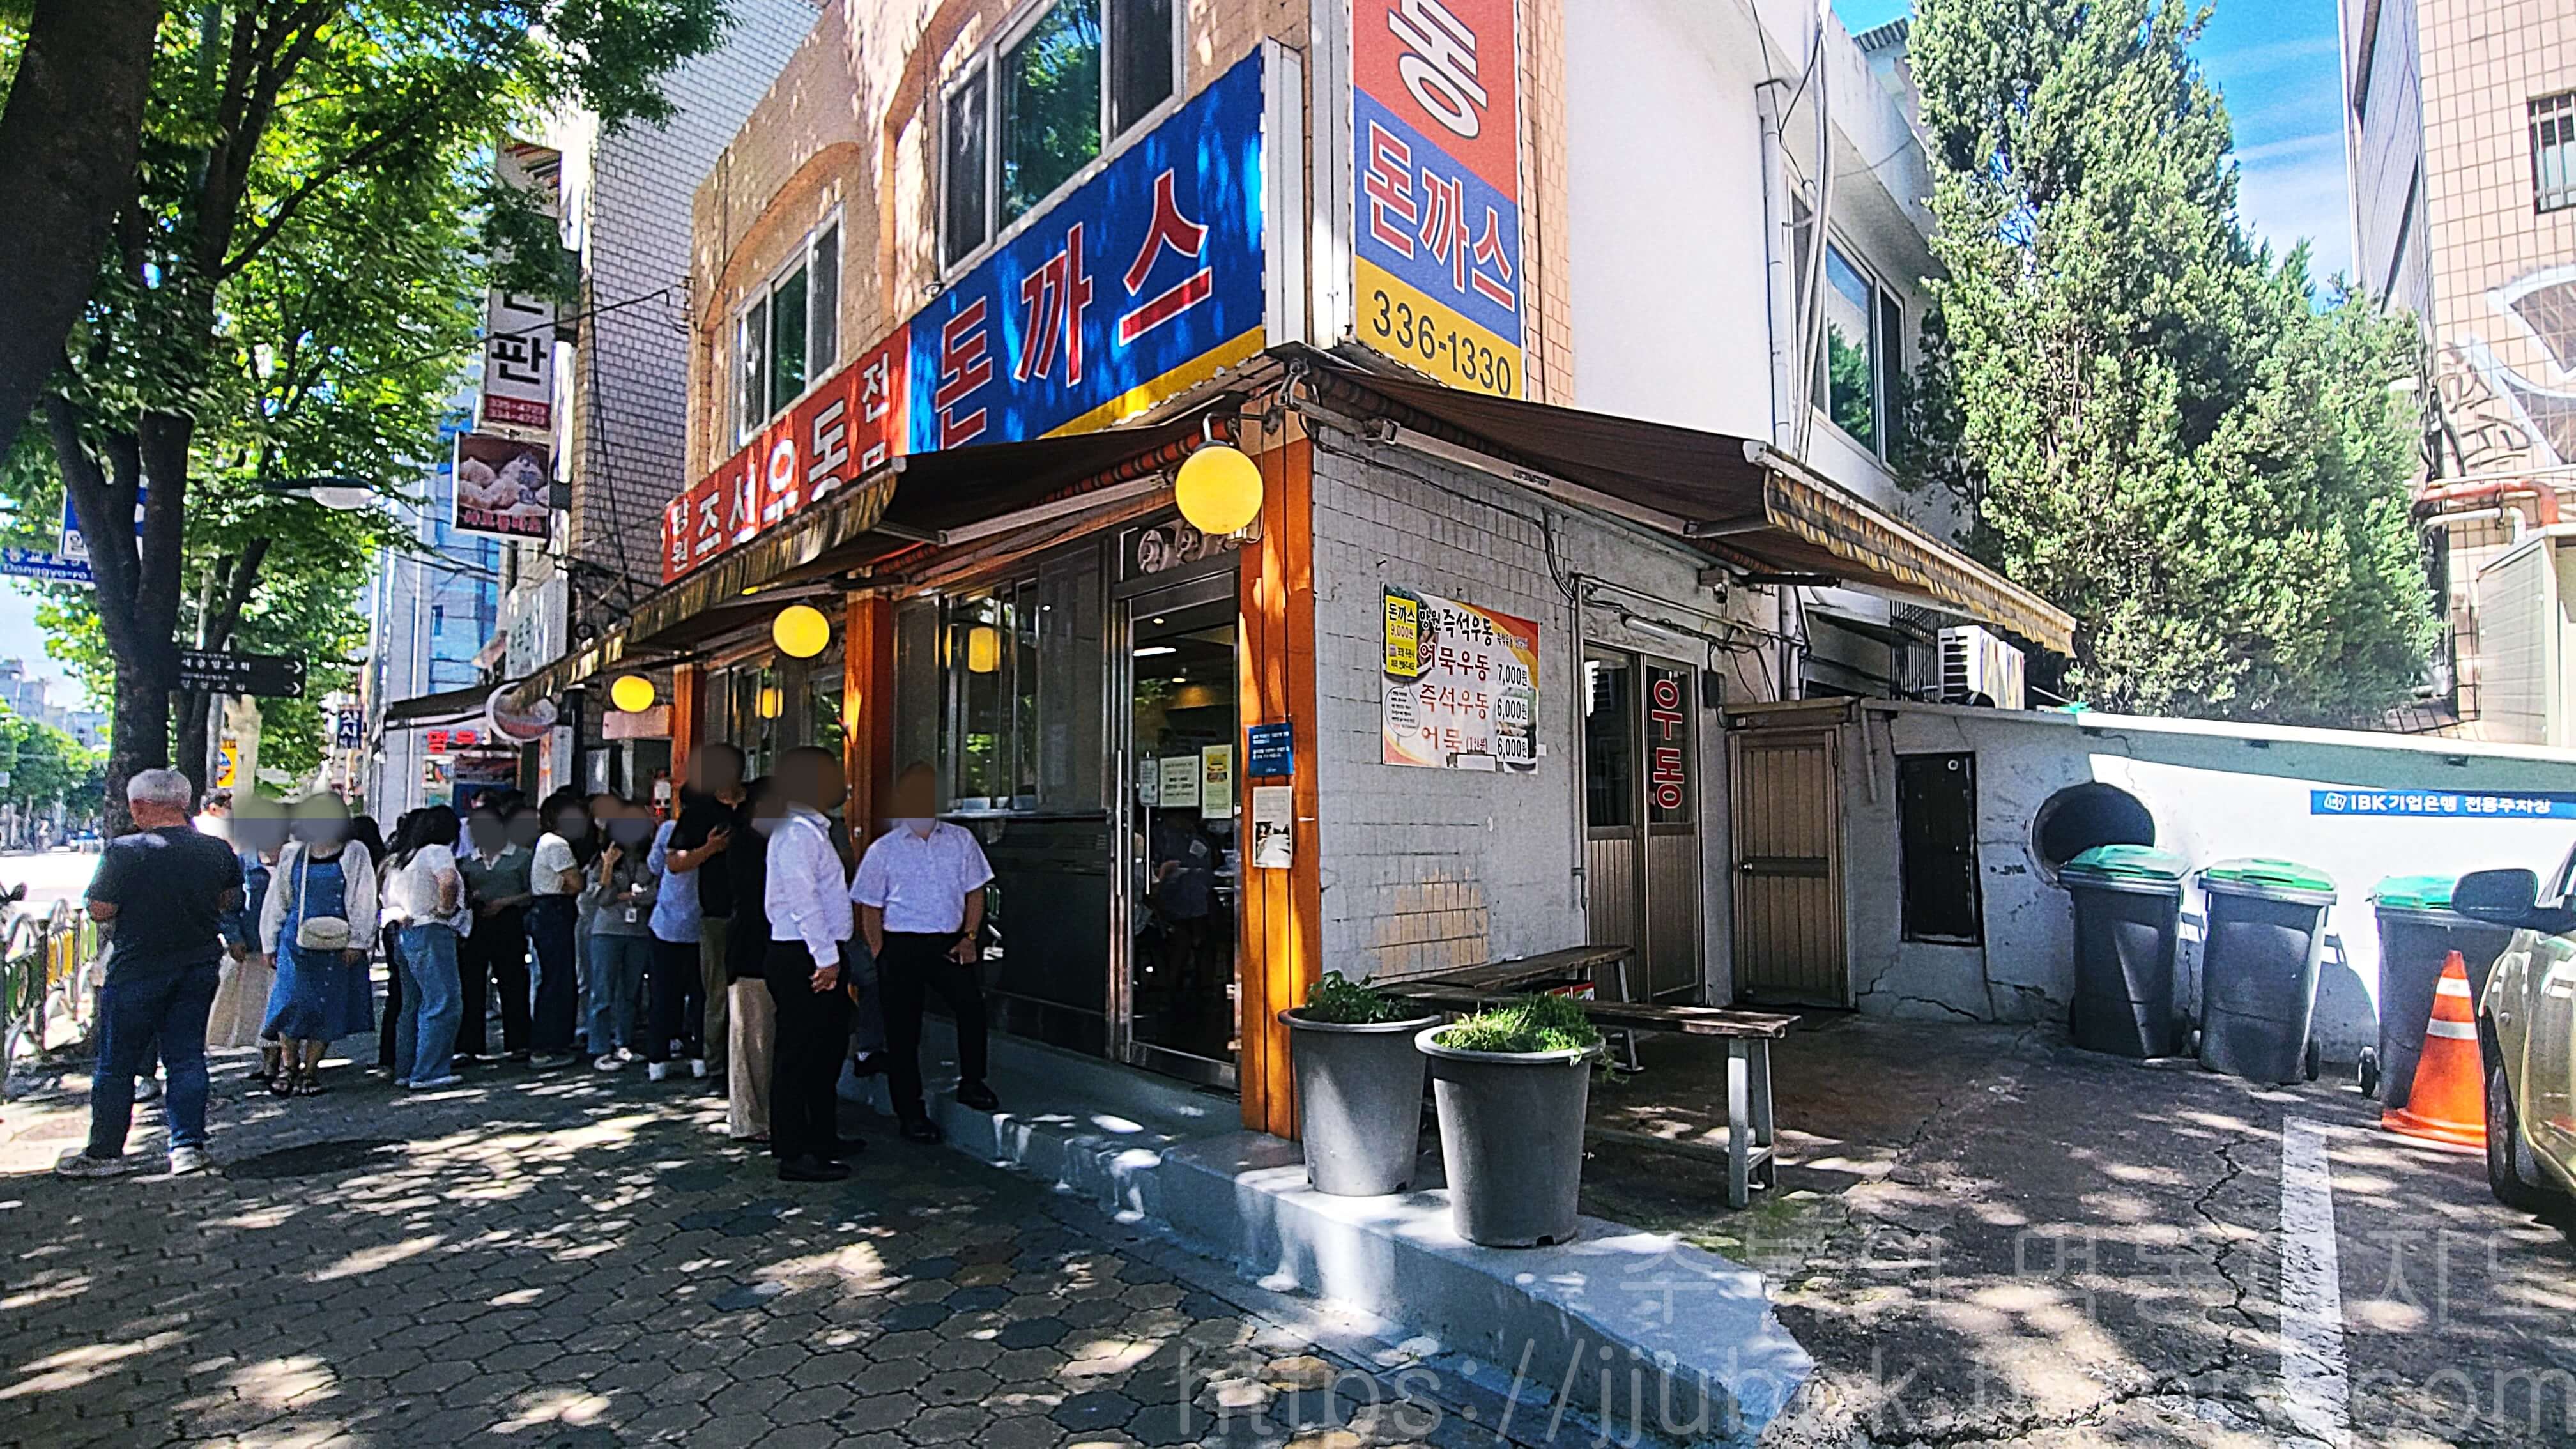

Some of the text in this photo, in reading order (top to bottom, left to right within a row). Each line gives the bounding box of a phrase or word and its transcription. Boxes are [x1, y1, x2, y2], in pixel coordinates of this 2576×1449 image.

[1364, 119, 1515, 312] 돈까스
[935, 167, 1213, 450] 돈까스
[1373, 289, 1511, 397] 336-1330
[1388, 602, 1415, 623] 돈까스
[1419, 608, 1441, 632] 망원
[1443, 609, 1494, 646] 즉석우동
[1420, 643, 1490, 682] 어묵우동
[1498, 663, 1528, 686] 7,000원
[1420, 683, 1489, 719] 즉석우동
[1497, 698, 1527, 720] 6,000원
[1421, 726, 1462, 753] 어묵
[1498, 737, 1527, 760] 6,000원
[1652, 679, 1685, 809] 우동
